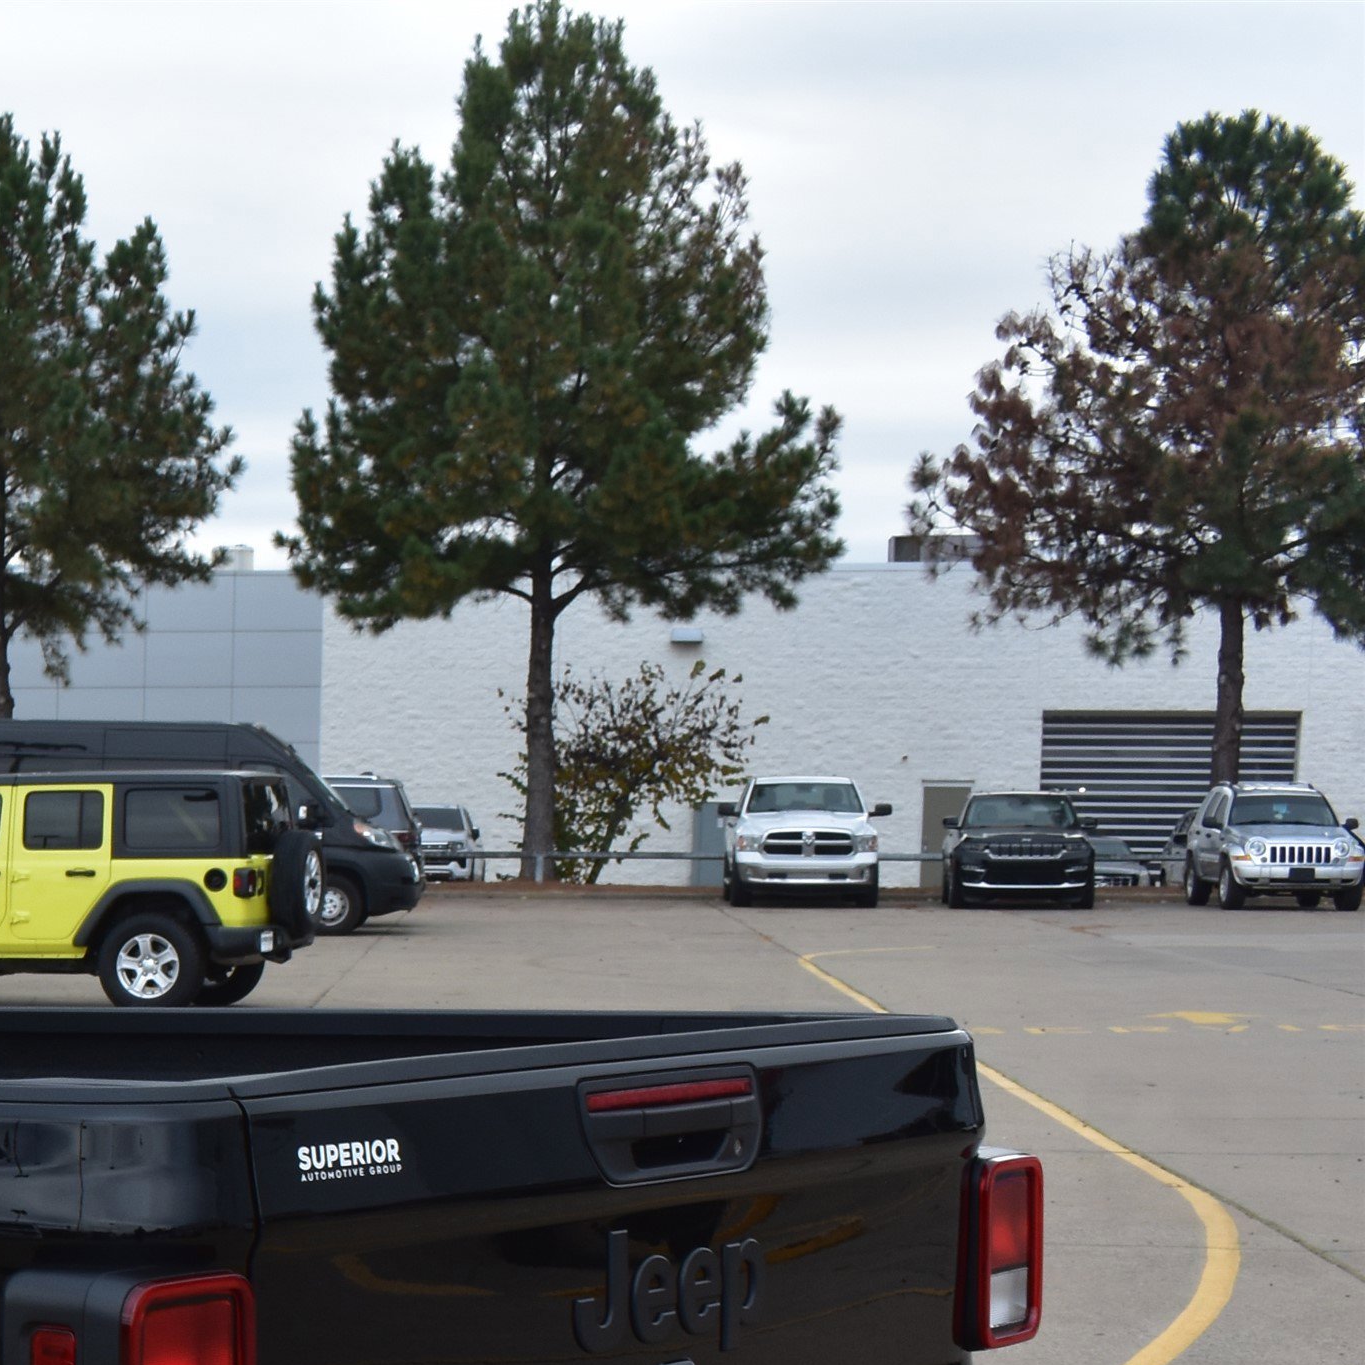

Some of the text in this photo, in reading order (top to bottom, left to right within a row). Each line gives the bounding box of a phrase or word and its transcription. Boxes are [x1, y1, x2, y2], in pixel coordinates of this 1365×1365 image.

[297, 1138, 401, 1171] SUPERIOR
[301, 1163, 403, 1182] AUTOMOTIVE GROUP
[573, 1229, 766, 1353] Jeep
